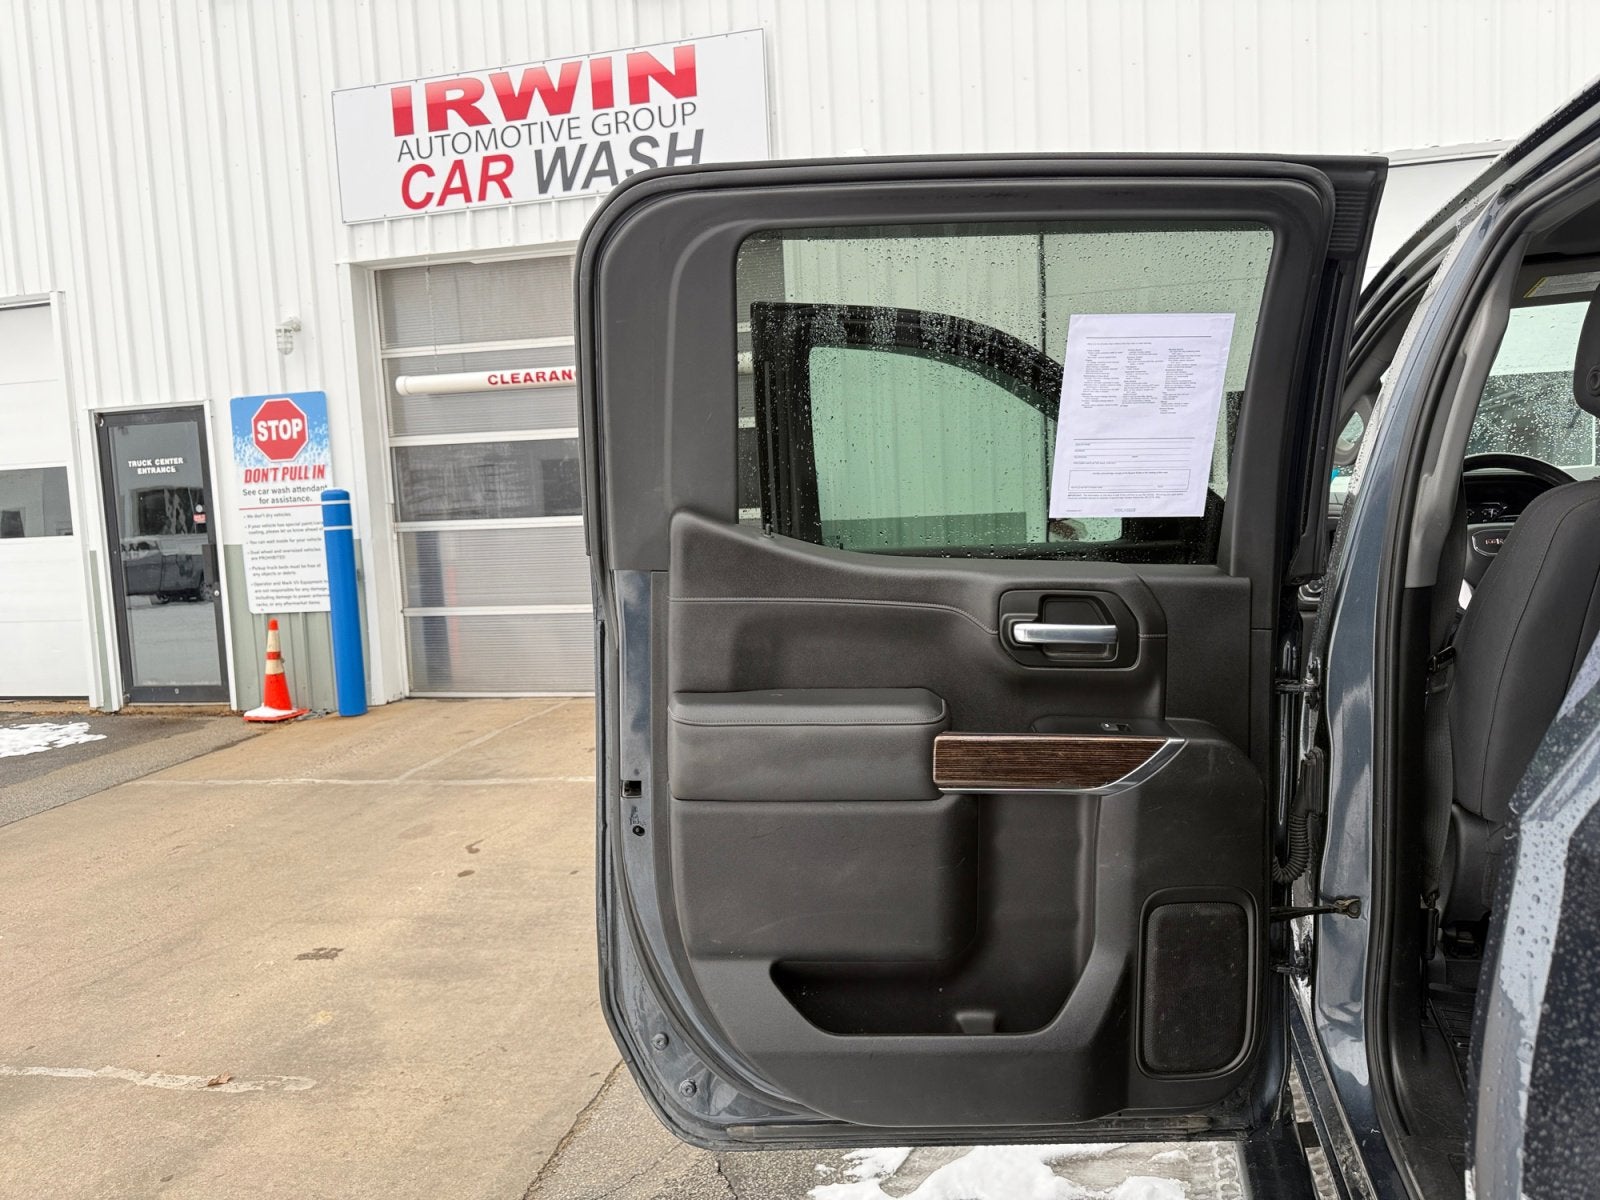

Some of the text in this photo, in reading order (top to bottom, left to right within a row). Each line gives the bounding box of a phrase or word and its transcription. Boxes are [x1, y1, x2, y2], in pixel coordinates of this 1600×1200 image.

[390, 44, 697, 137] IRWIN
[397, 101, 697, 163] AUTOMOTIVE GROUP
[401, 128, 704, 210] CAR WASH
[488, 369, 577, 385] CLEARAN
[256, 418, 303, 442] STOP
[128, 457, 184, 468] TRUCK CENTER
[137, 466, 177, 475] ENTRANCE
[244, 464, 325, 484] DON'T PULL IN
[242, 488, 257, 496] See
[271, 486, 291, 494] wash
[270, 495, 313, 504] assistance.
